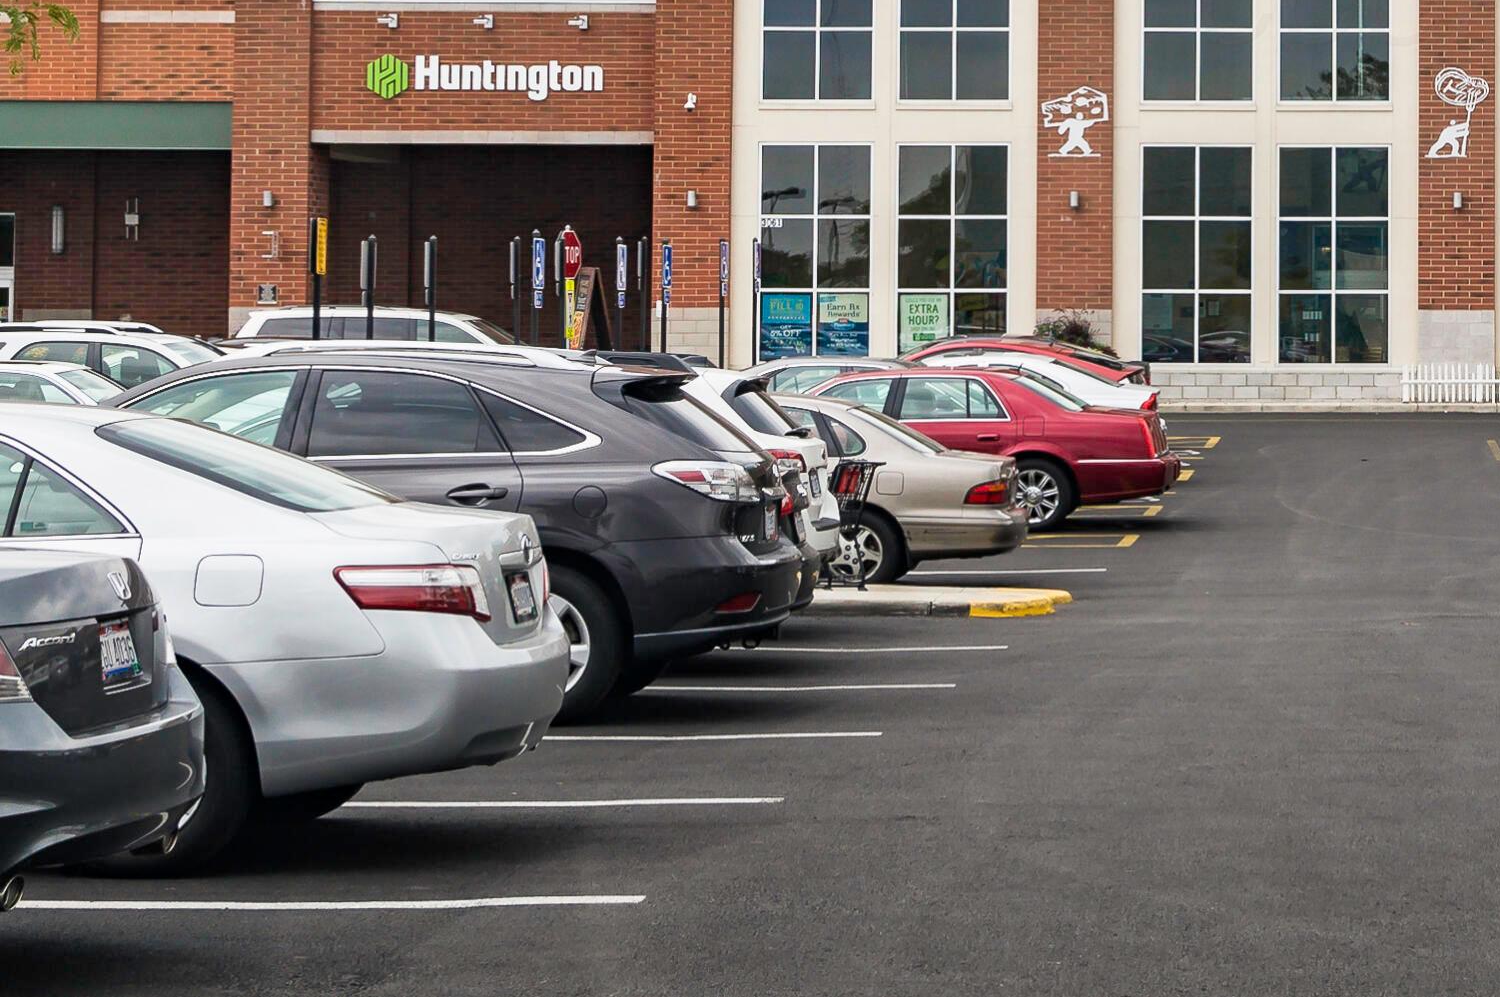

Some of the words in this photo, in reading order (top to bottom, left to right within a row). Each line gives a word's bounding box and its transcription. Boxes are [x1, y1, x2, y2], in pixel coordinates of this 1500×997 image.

[414, 54, 604, 101] Huntington
[564, 246, 580, 263] TOP
[909, 304, 939, 314] EXTRA
[908, 315, 940, 325] HOUR?
[783, 329, 801, 337] OFF
[18, 632, 76, 651] Accord
